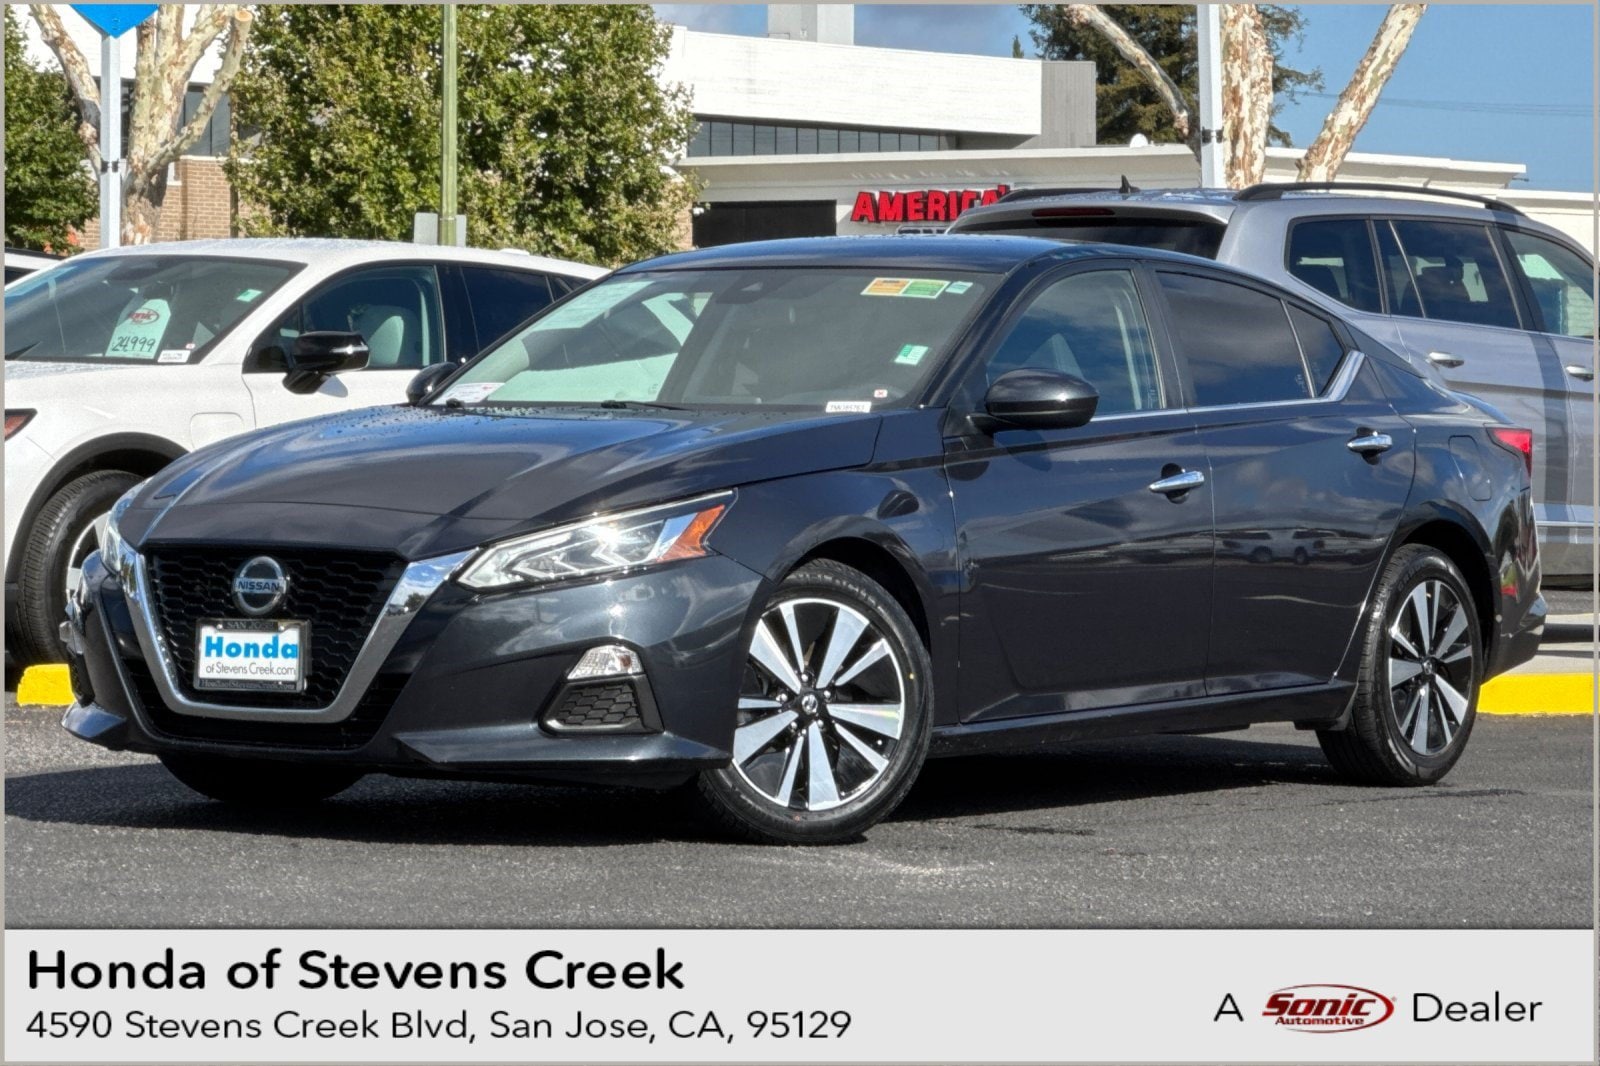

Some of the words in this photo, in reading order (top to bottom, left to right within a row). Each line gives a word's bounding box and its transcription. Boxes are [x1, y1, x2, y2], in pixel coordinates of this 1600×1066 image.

[238, 581, 280, 591] NISSAN
[204, 634, 298, 659] Honda
[205, 663, 216, 674] of
[216, 661, 248, 674] Stevens
